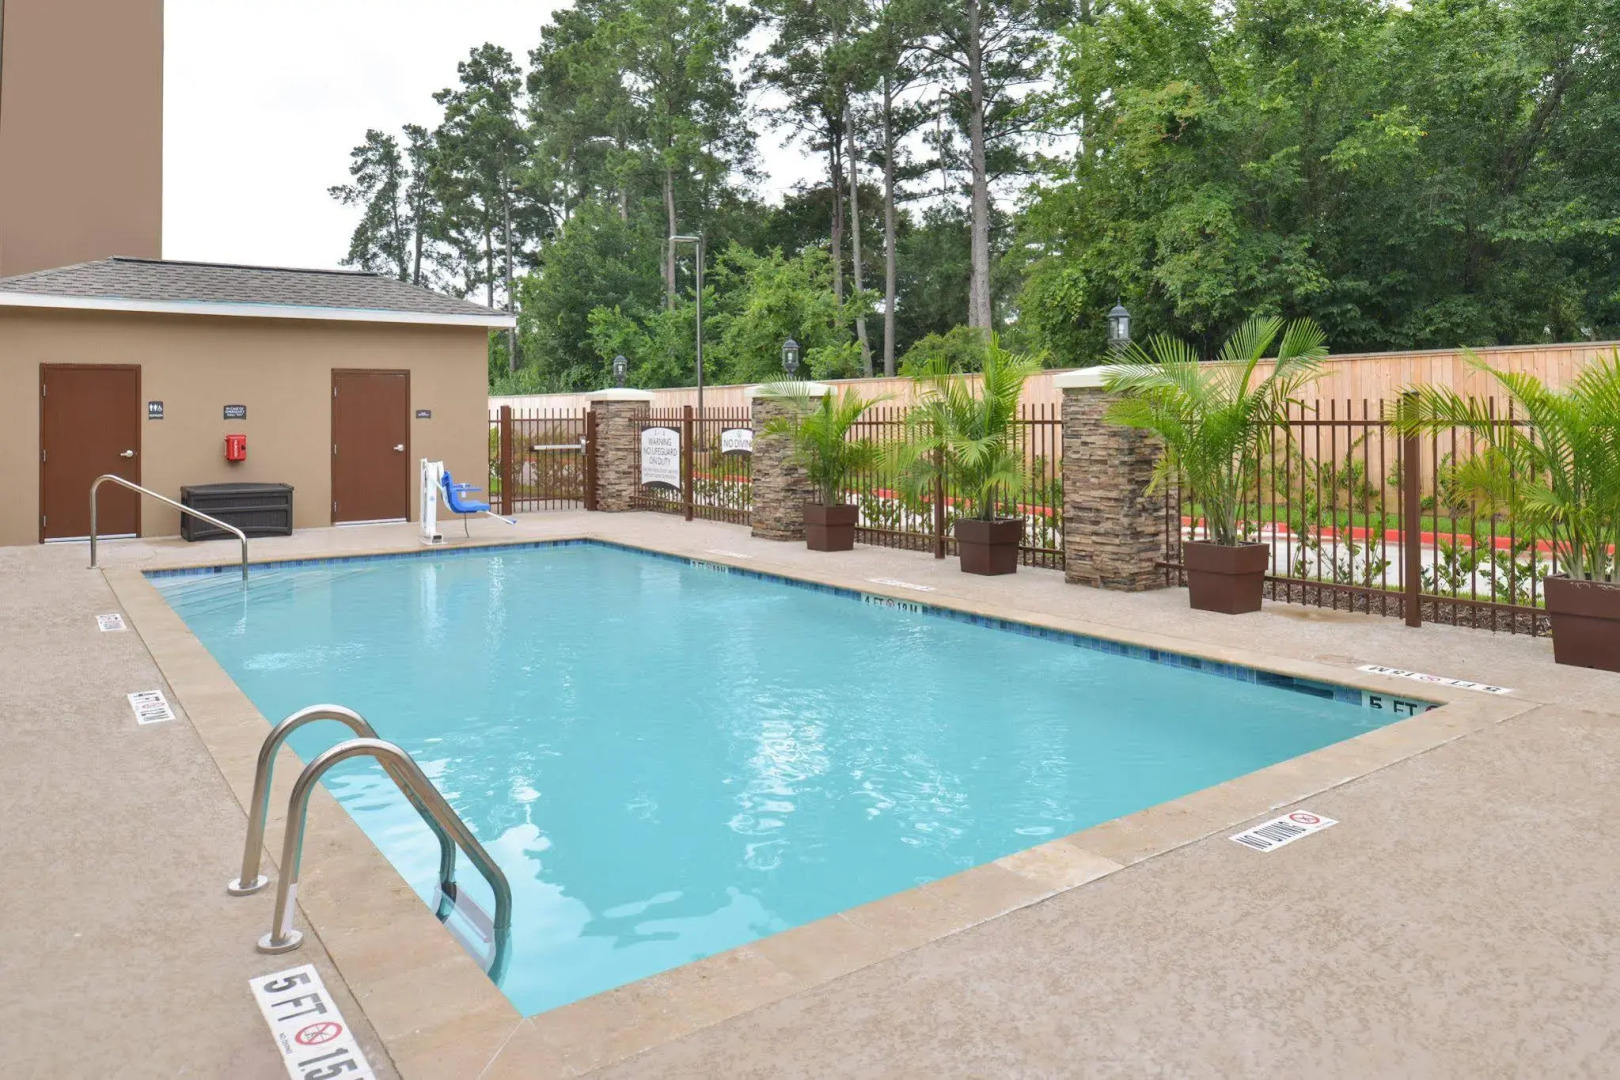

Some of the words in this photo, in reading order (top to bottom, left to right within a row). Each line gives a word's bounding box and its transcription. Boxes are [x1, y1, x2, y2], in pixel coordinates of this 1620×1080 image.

[648, 438, 672, 446] WARNING
[724, 439, 733, 448] NO
[735, 439, 752, 448] DIVIN
[652, 448, 677, 456] LIFEGUARD
[649, 456, 658, 464] ON
[658, 457, 671, 466] DUTY
[865, 595, 870, 604] 4
[1369, 696, 1382, 709] 5
[1394, 700, 1417, 716] FT
[264, 972, 311, 993] 5
[271, 993, 328, 1022] FT
